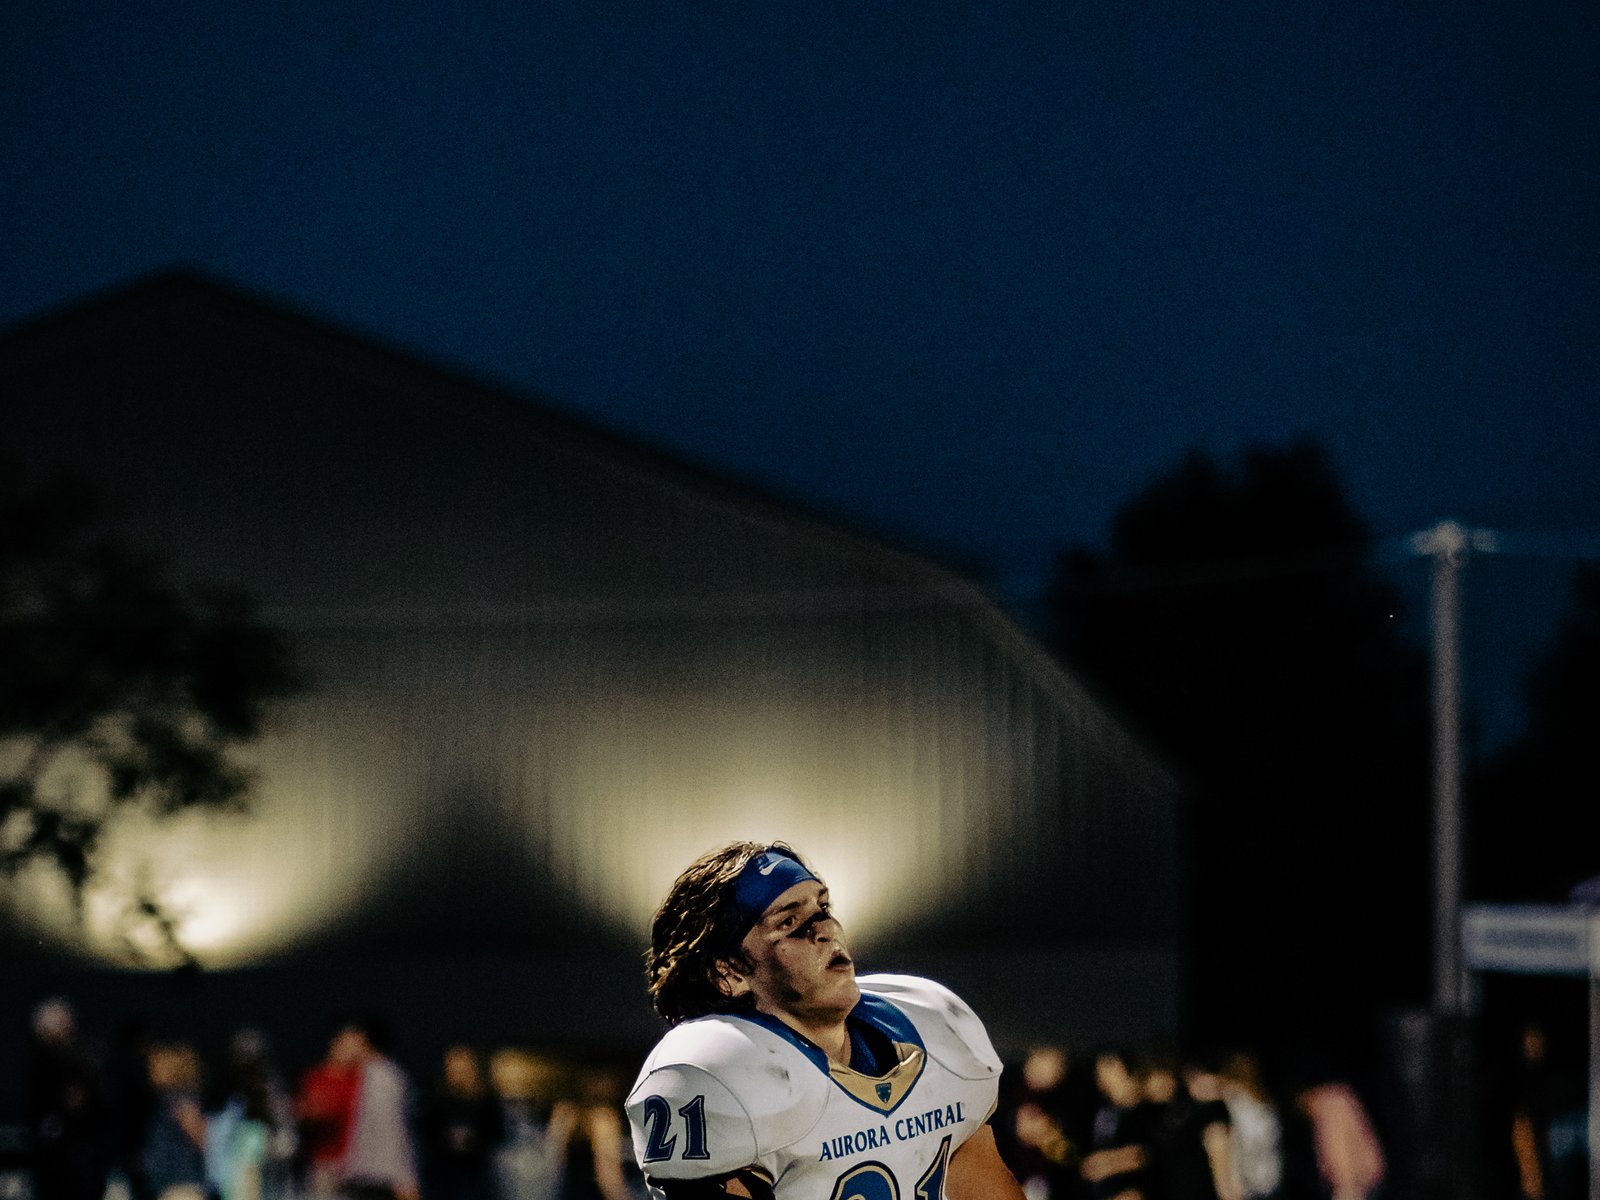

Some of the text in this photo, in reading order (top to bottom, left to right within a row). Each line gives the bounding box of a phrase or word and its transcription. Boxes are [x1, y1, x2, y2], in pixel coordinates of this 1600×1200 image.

[643, 1094, 711, 1163] 21
[819, 1101, 965, 1162] AURORA CENTRAL
